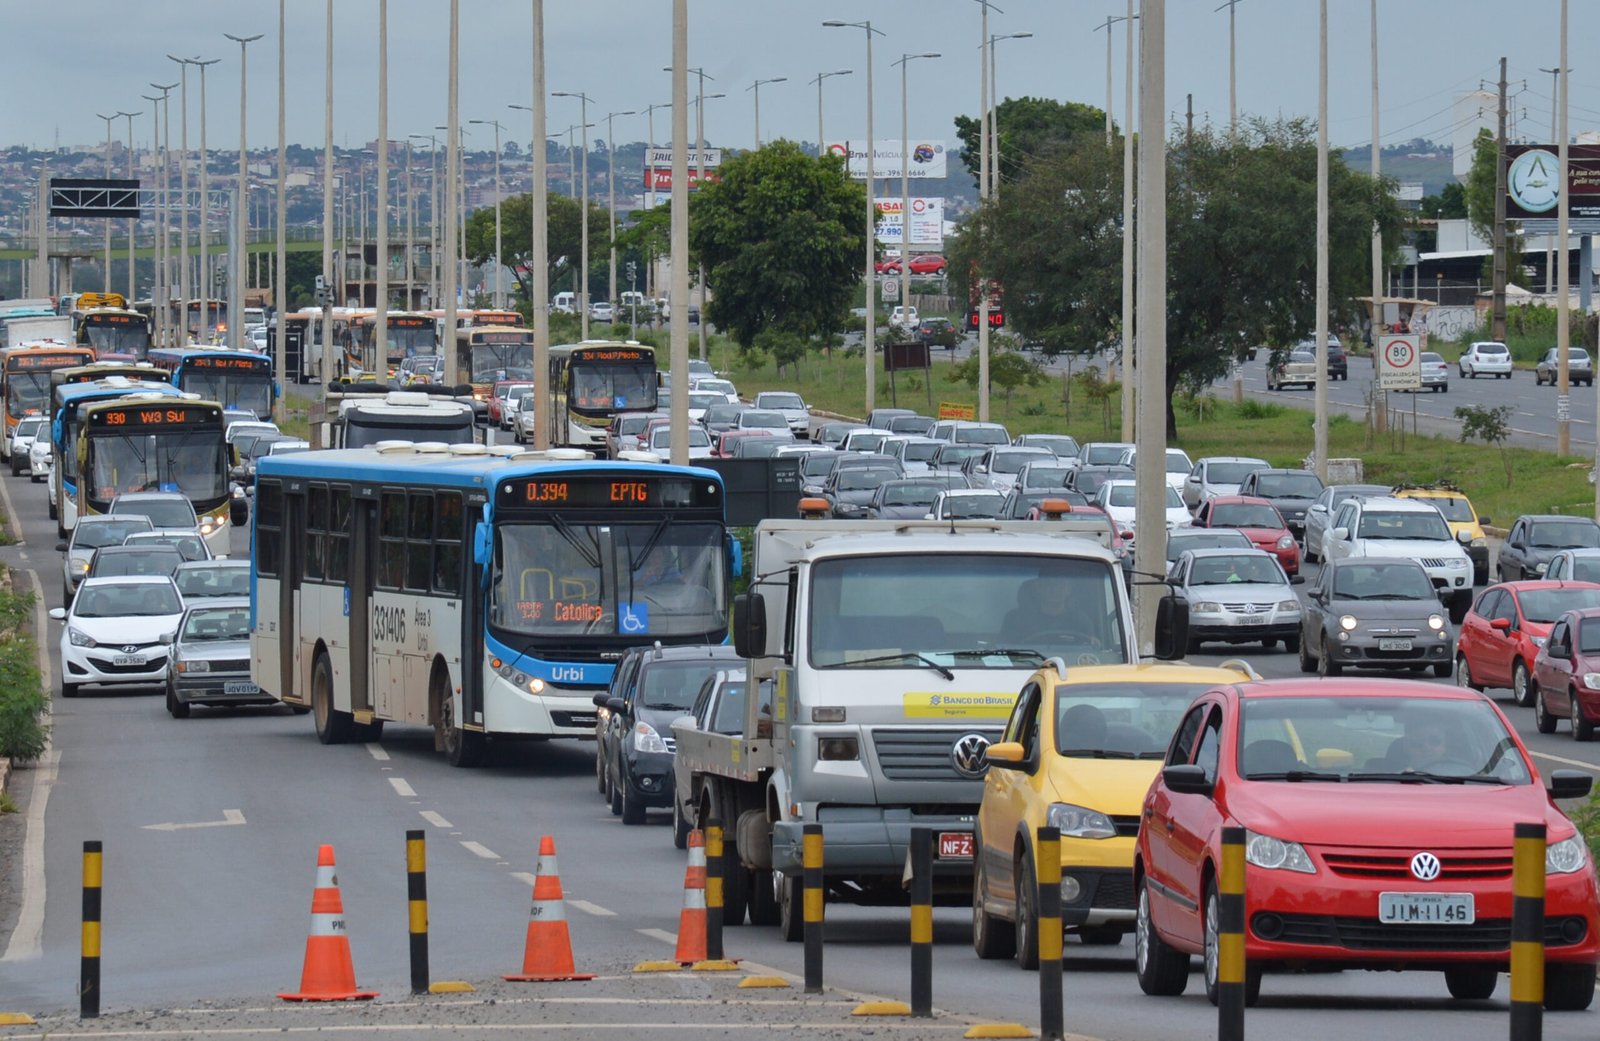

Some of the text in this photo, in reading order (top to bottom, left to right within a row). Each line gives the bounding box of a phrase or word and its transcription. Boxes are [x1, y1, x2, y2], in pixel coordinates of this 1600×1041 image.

[1393, 347, 1407, 357] 80
[107, 409, 185, 425] 930 W3 Sul
[526, 483, 648, 501] 0.394 EPTG
[374, 604, 406, 644] 331406
[427, 608, 432, 628] 3
[552, 667, 584, 681] Urbi
[943, 696, 973, 704] BANCO
[985, 696, 1014, 705] BRASIL
